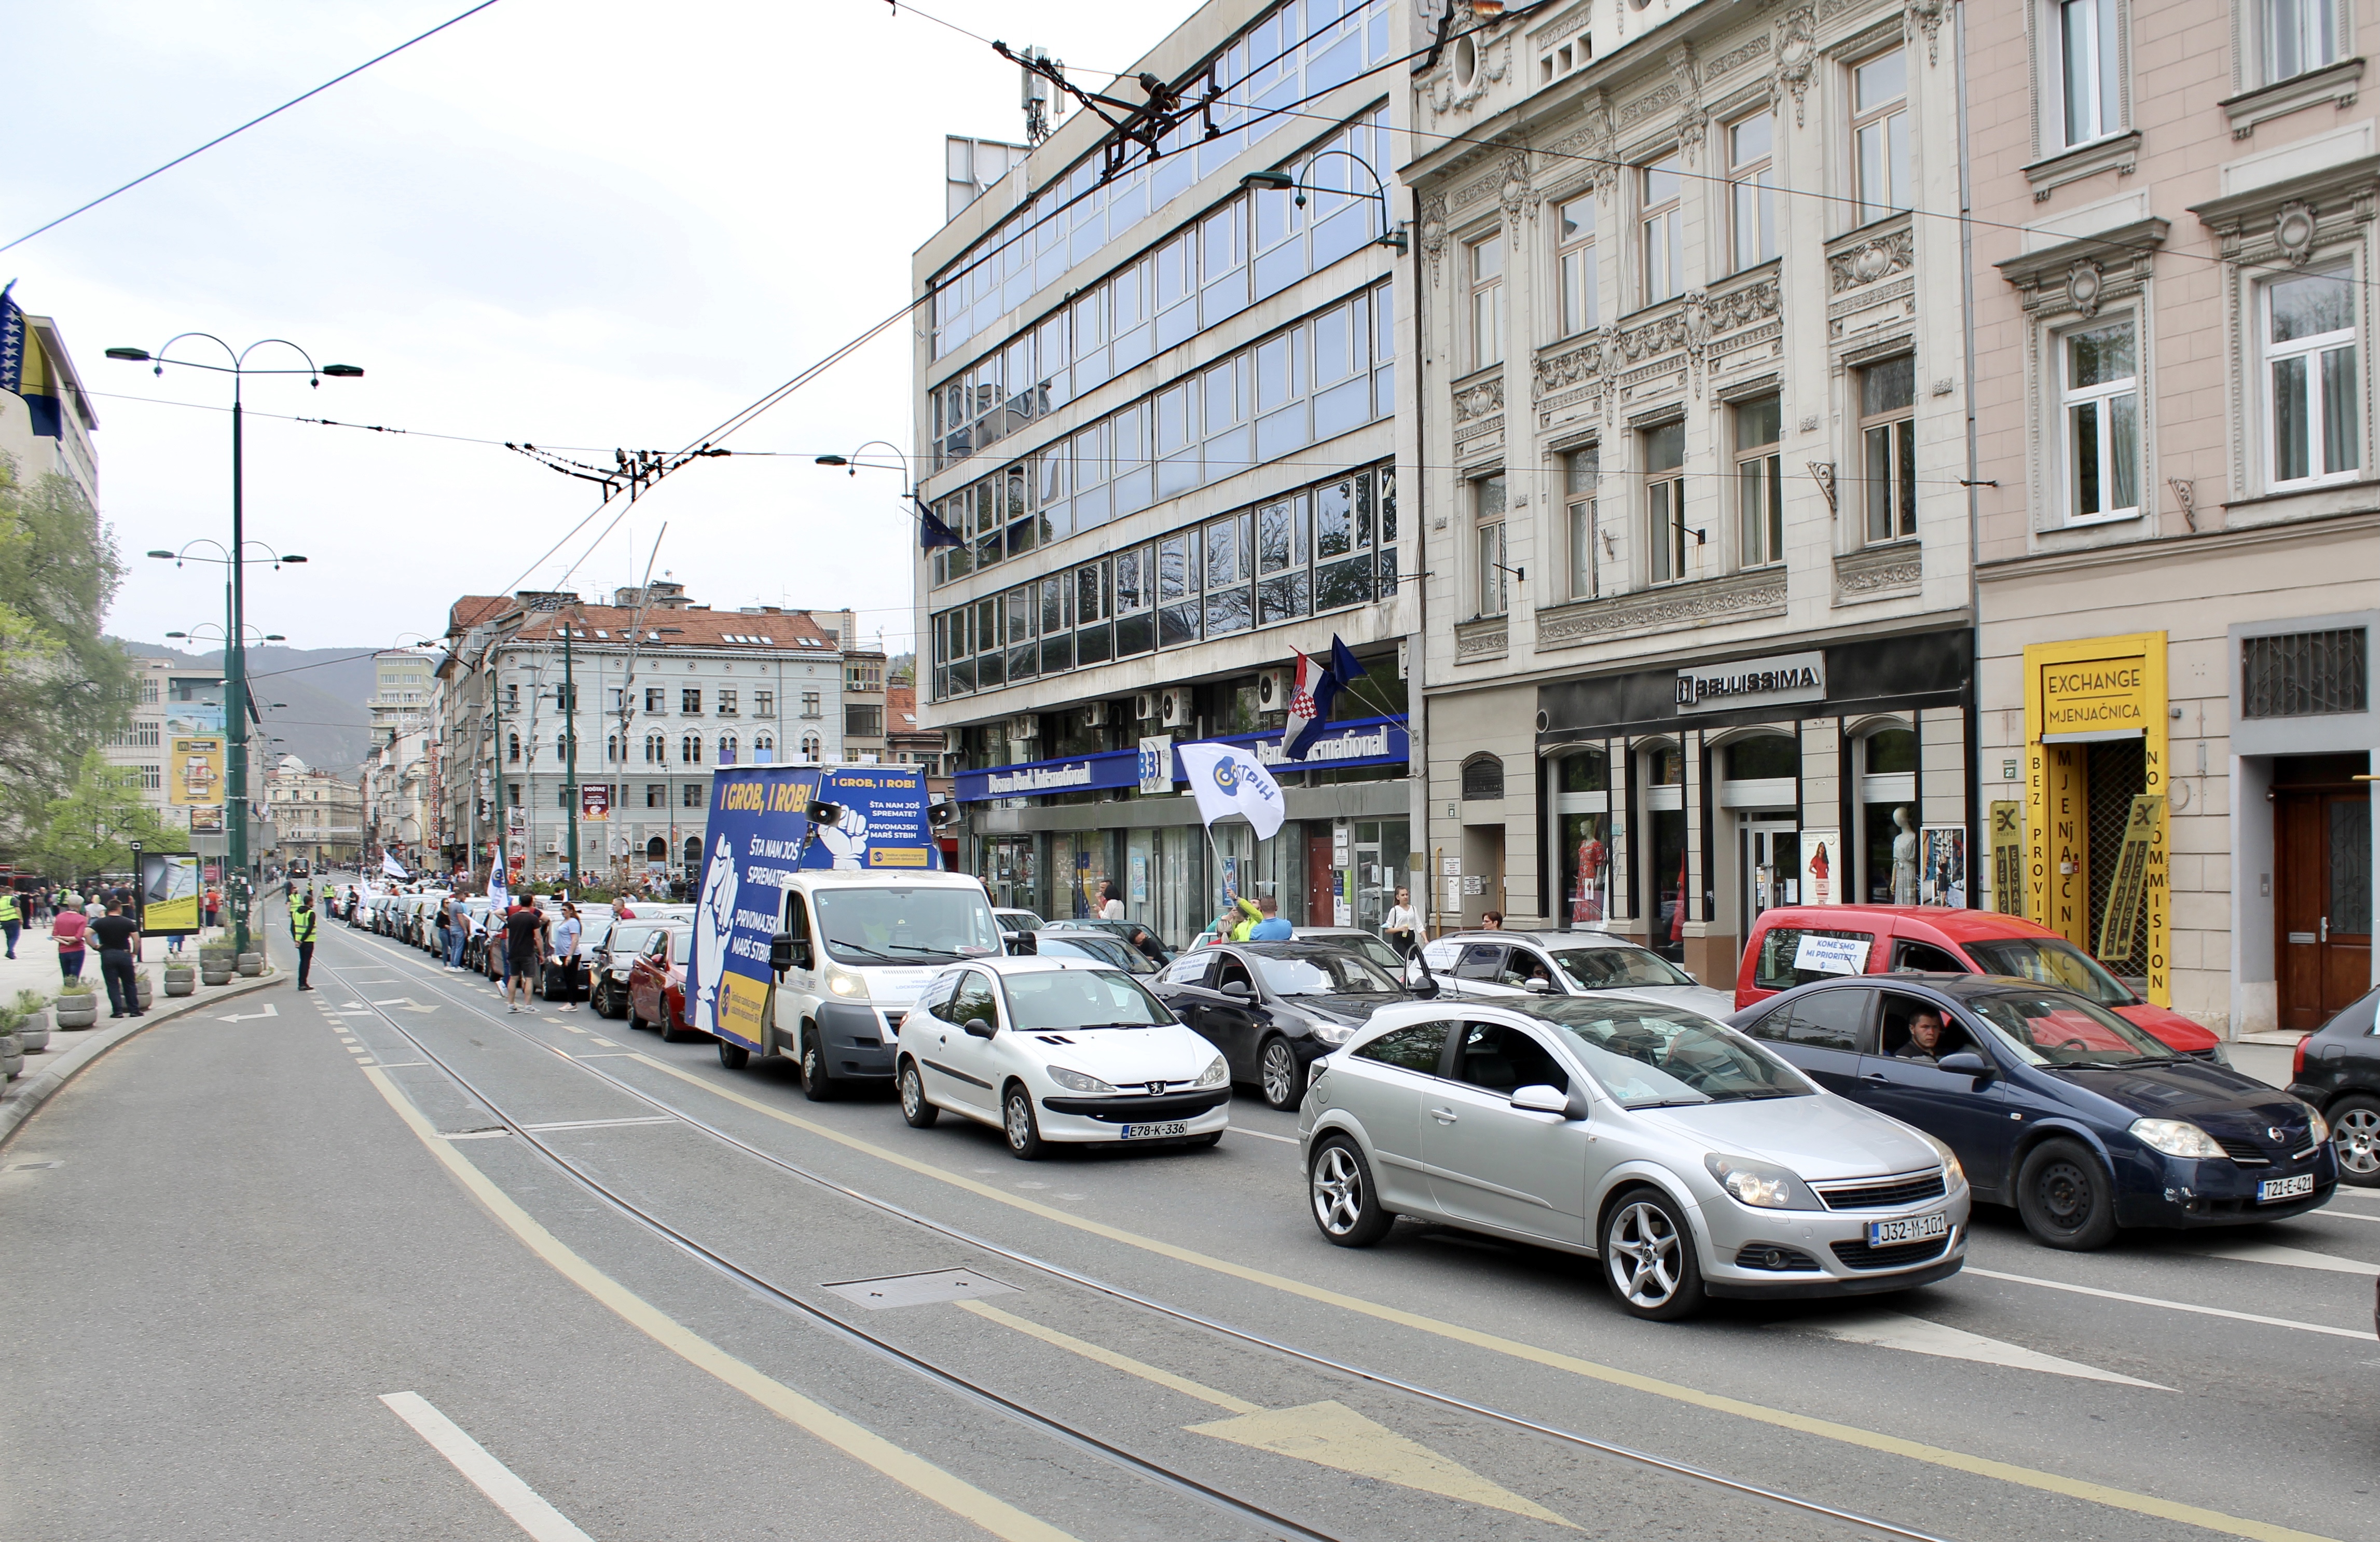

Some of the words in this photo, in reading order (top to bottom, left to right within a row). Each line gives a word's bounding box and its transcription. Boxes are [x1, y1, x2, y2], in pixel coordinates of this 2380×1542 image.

[1696, 667, 1819, 697] BELLISSIMA
[2049, 669, 2140, 694] EXCHANGE
[2050, 703, 2141, 723] MJENJAČNICA
[988, 774, 1013, 793] Bosna
[1012, 768, 1035, 791] Bank
[1034, 761, 1091, 789] International
[2147, 751, 2158, 785] NO
[431, 748, 439, 838] ENERGOPETROL
[839, 778, 876, 789] GROB,
[887, 779, 916, 788] ROB!
[2032, 758, 2041, 805] BEZ
[720, 784, 727, 810] I
[727, 782, 765, 817] GROB,
[767, 783, 776, 811] I
[774, 783, 812, 813] ROB!
[749, 833, 765, 856] ŠTA
[765, 839, 783, 858] NAM
[782, 837, 802, 861] JOŠ
[746, 865, 790, 888] SPREMATE
[2123, 846, 2145, 929] EXCHANGE
[2149, 821, 2164, 988] OMMISION
[732, 934, 753, 959] MARŠ
[1816, 951, 1858, 961] PRIORITET?
[1817, 940, 1839, 948] KOME
[1130, 1123, 1185, 1136] E78-K-336
[2266, 1176, 2312, 1197] T21-E-421
[1881, 1216, 1944, 1241] J32-M-101
